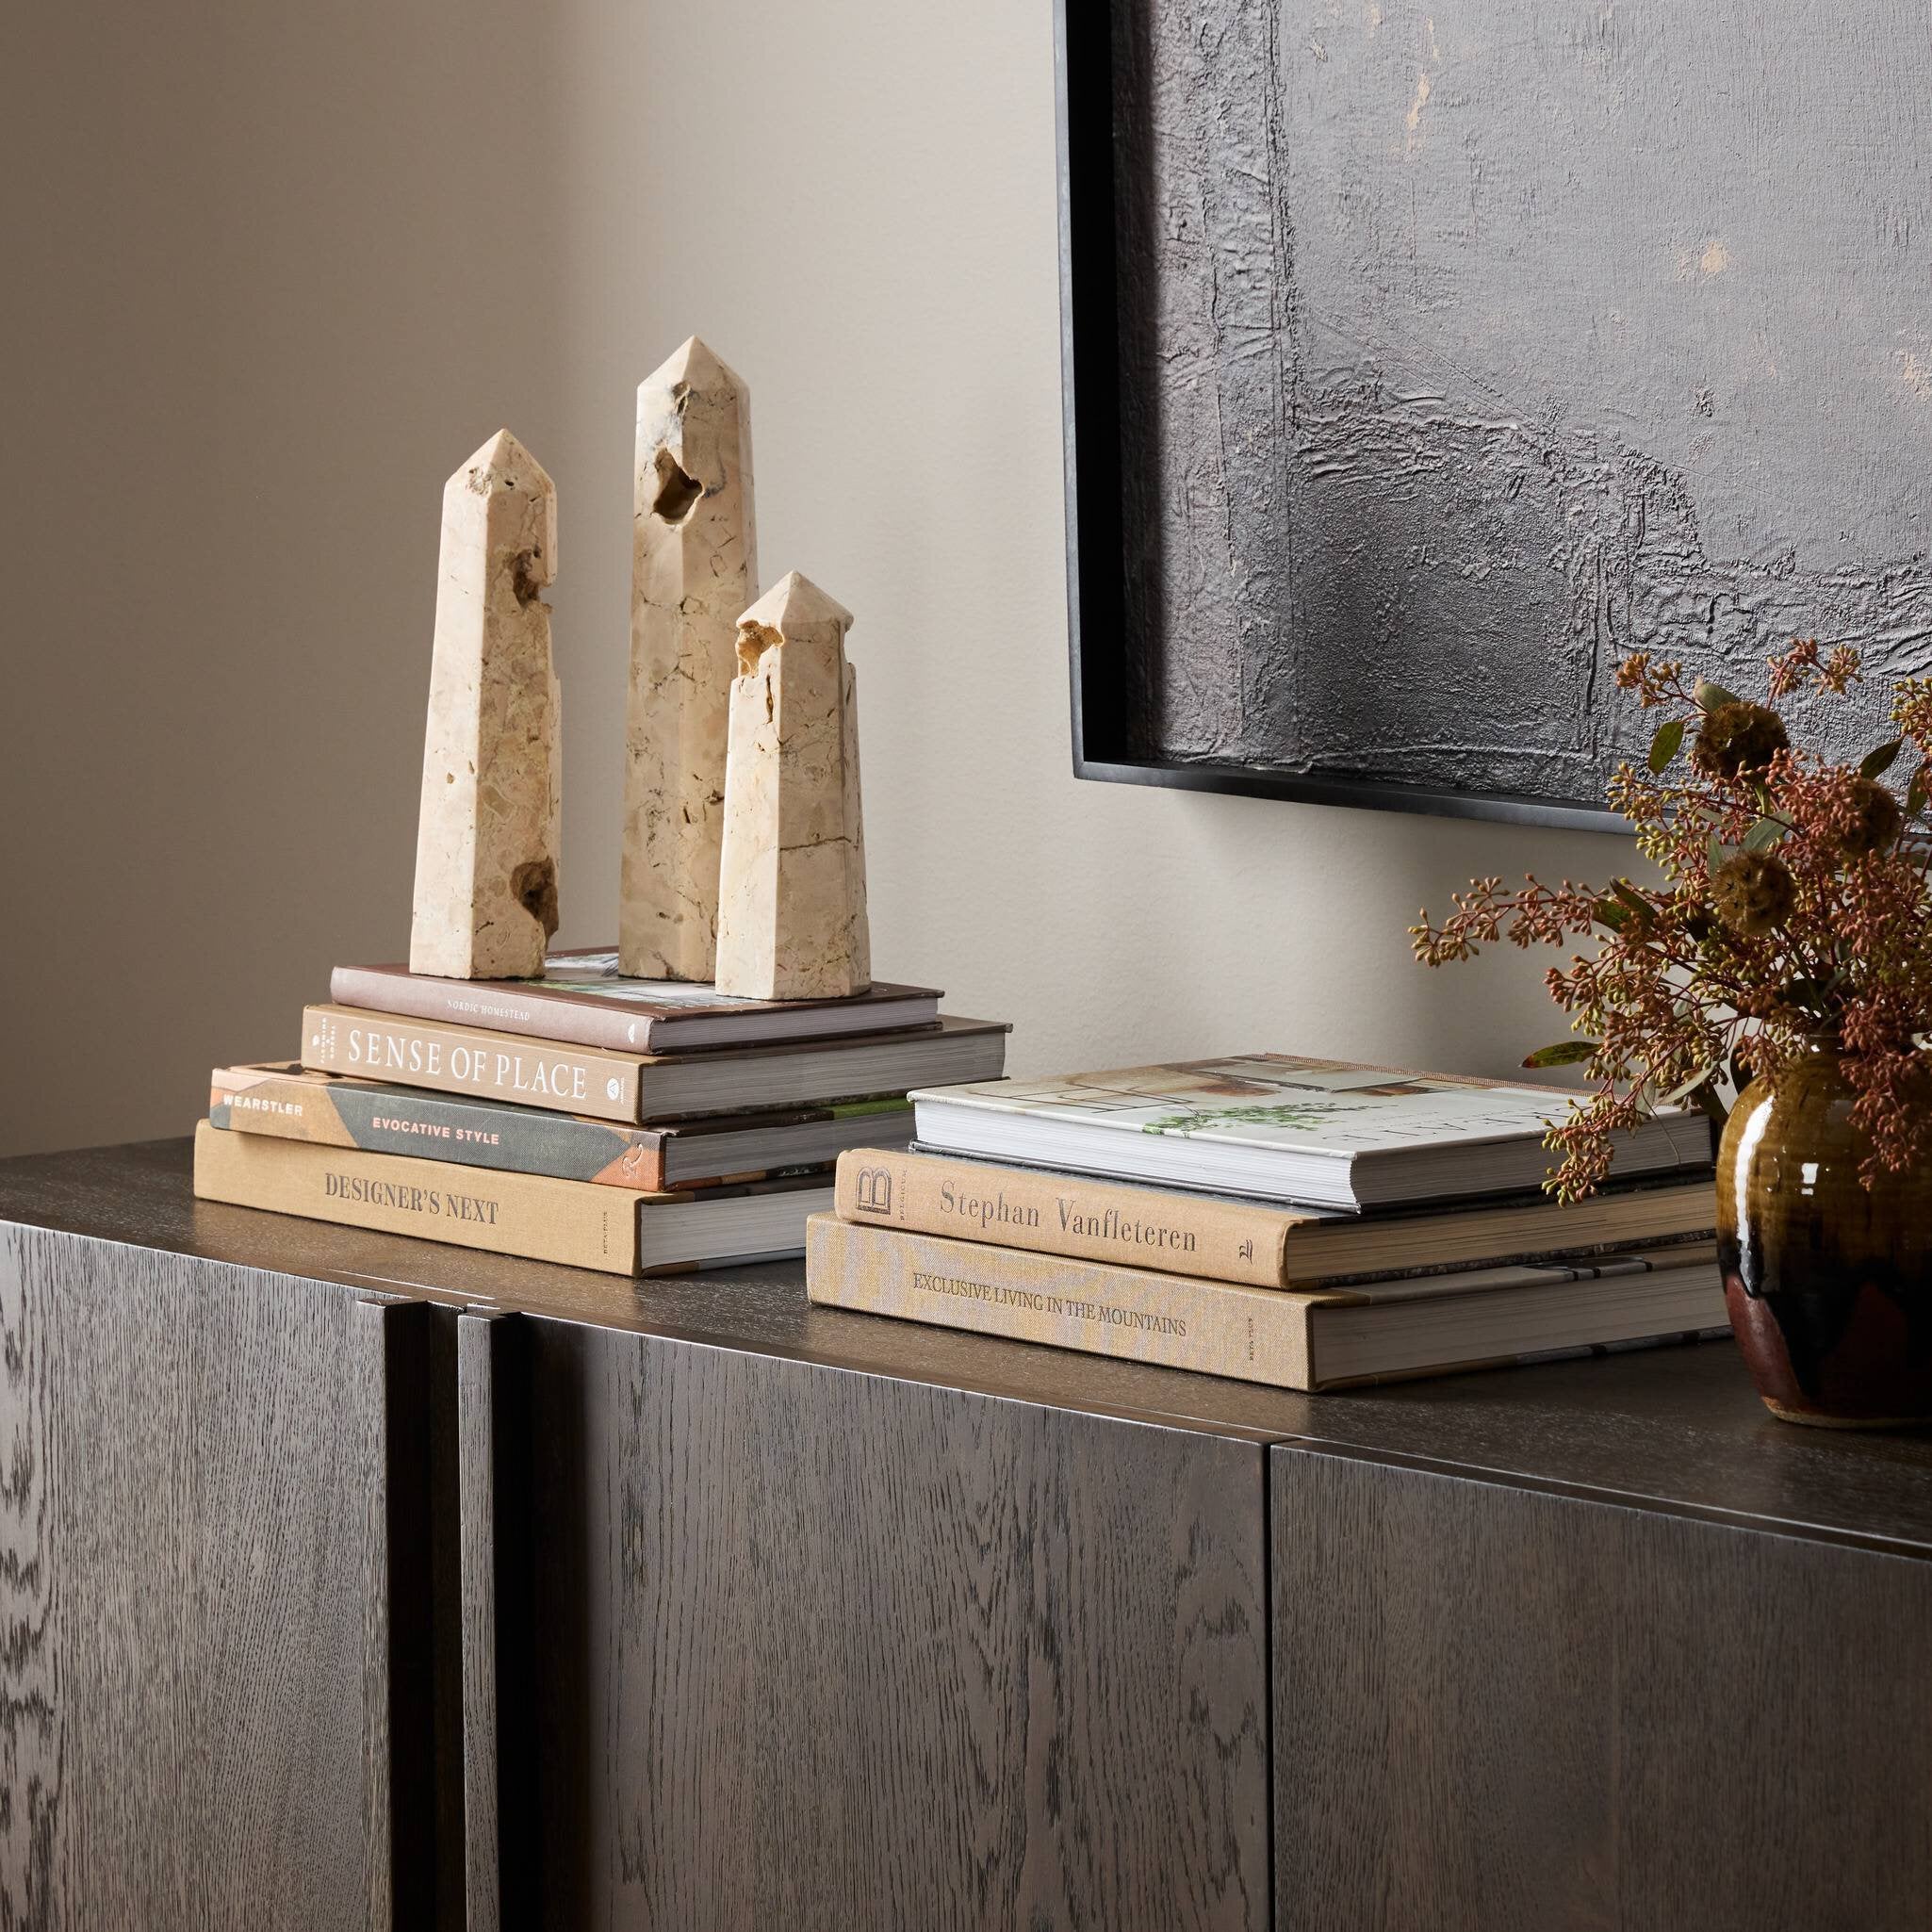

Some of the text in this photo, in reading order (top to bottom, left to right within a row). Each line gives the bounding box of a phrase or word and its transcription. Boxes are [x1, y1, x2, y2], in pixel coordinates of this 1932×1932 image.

[447, 999, 530, 1021] NORDIC HOMESTEAD
[349, 1029, 442, 1075] SENSE
[450, 1047, 487, 1082] OF
[495, 1054, 587, 1099] PLACE
[222, 1093, 303, 1117] WEARSTLER
[372, 1117, 499, 1145] EVOCATIVE STYLE
[325, 1172, 499, 1225] DESIGNER'S NEXT
[940, 1180, 1198, 1253] Stephan Vanfleteren
[912, 1272, 1187, 1337] EXCLUSIVE LIVING IN THE MOUNTAINS
